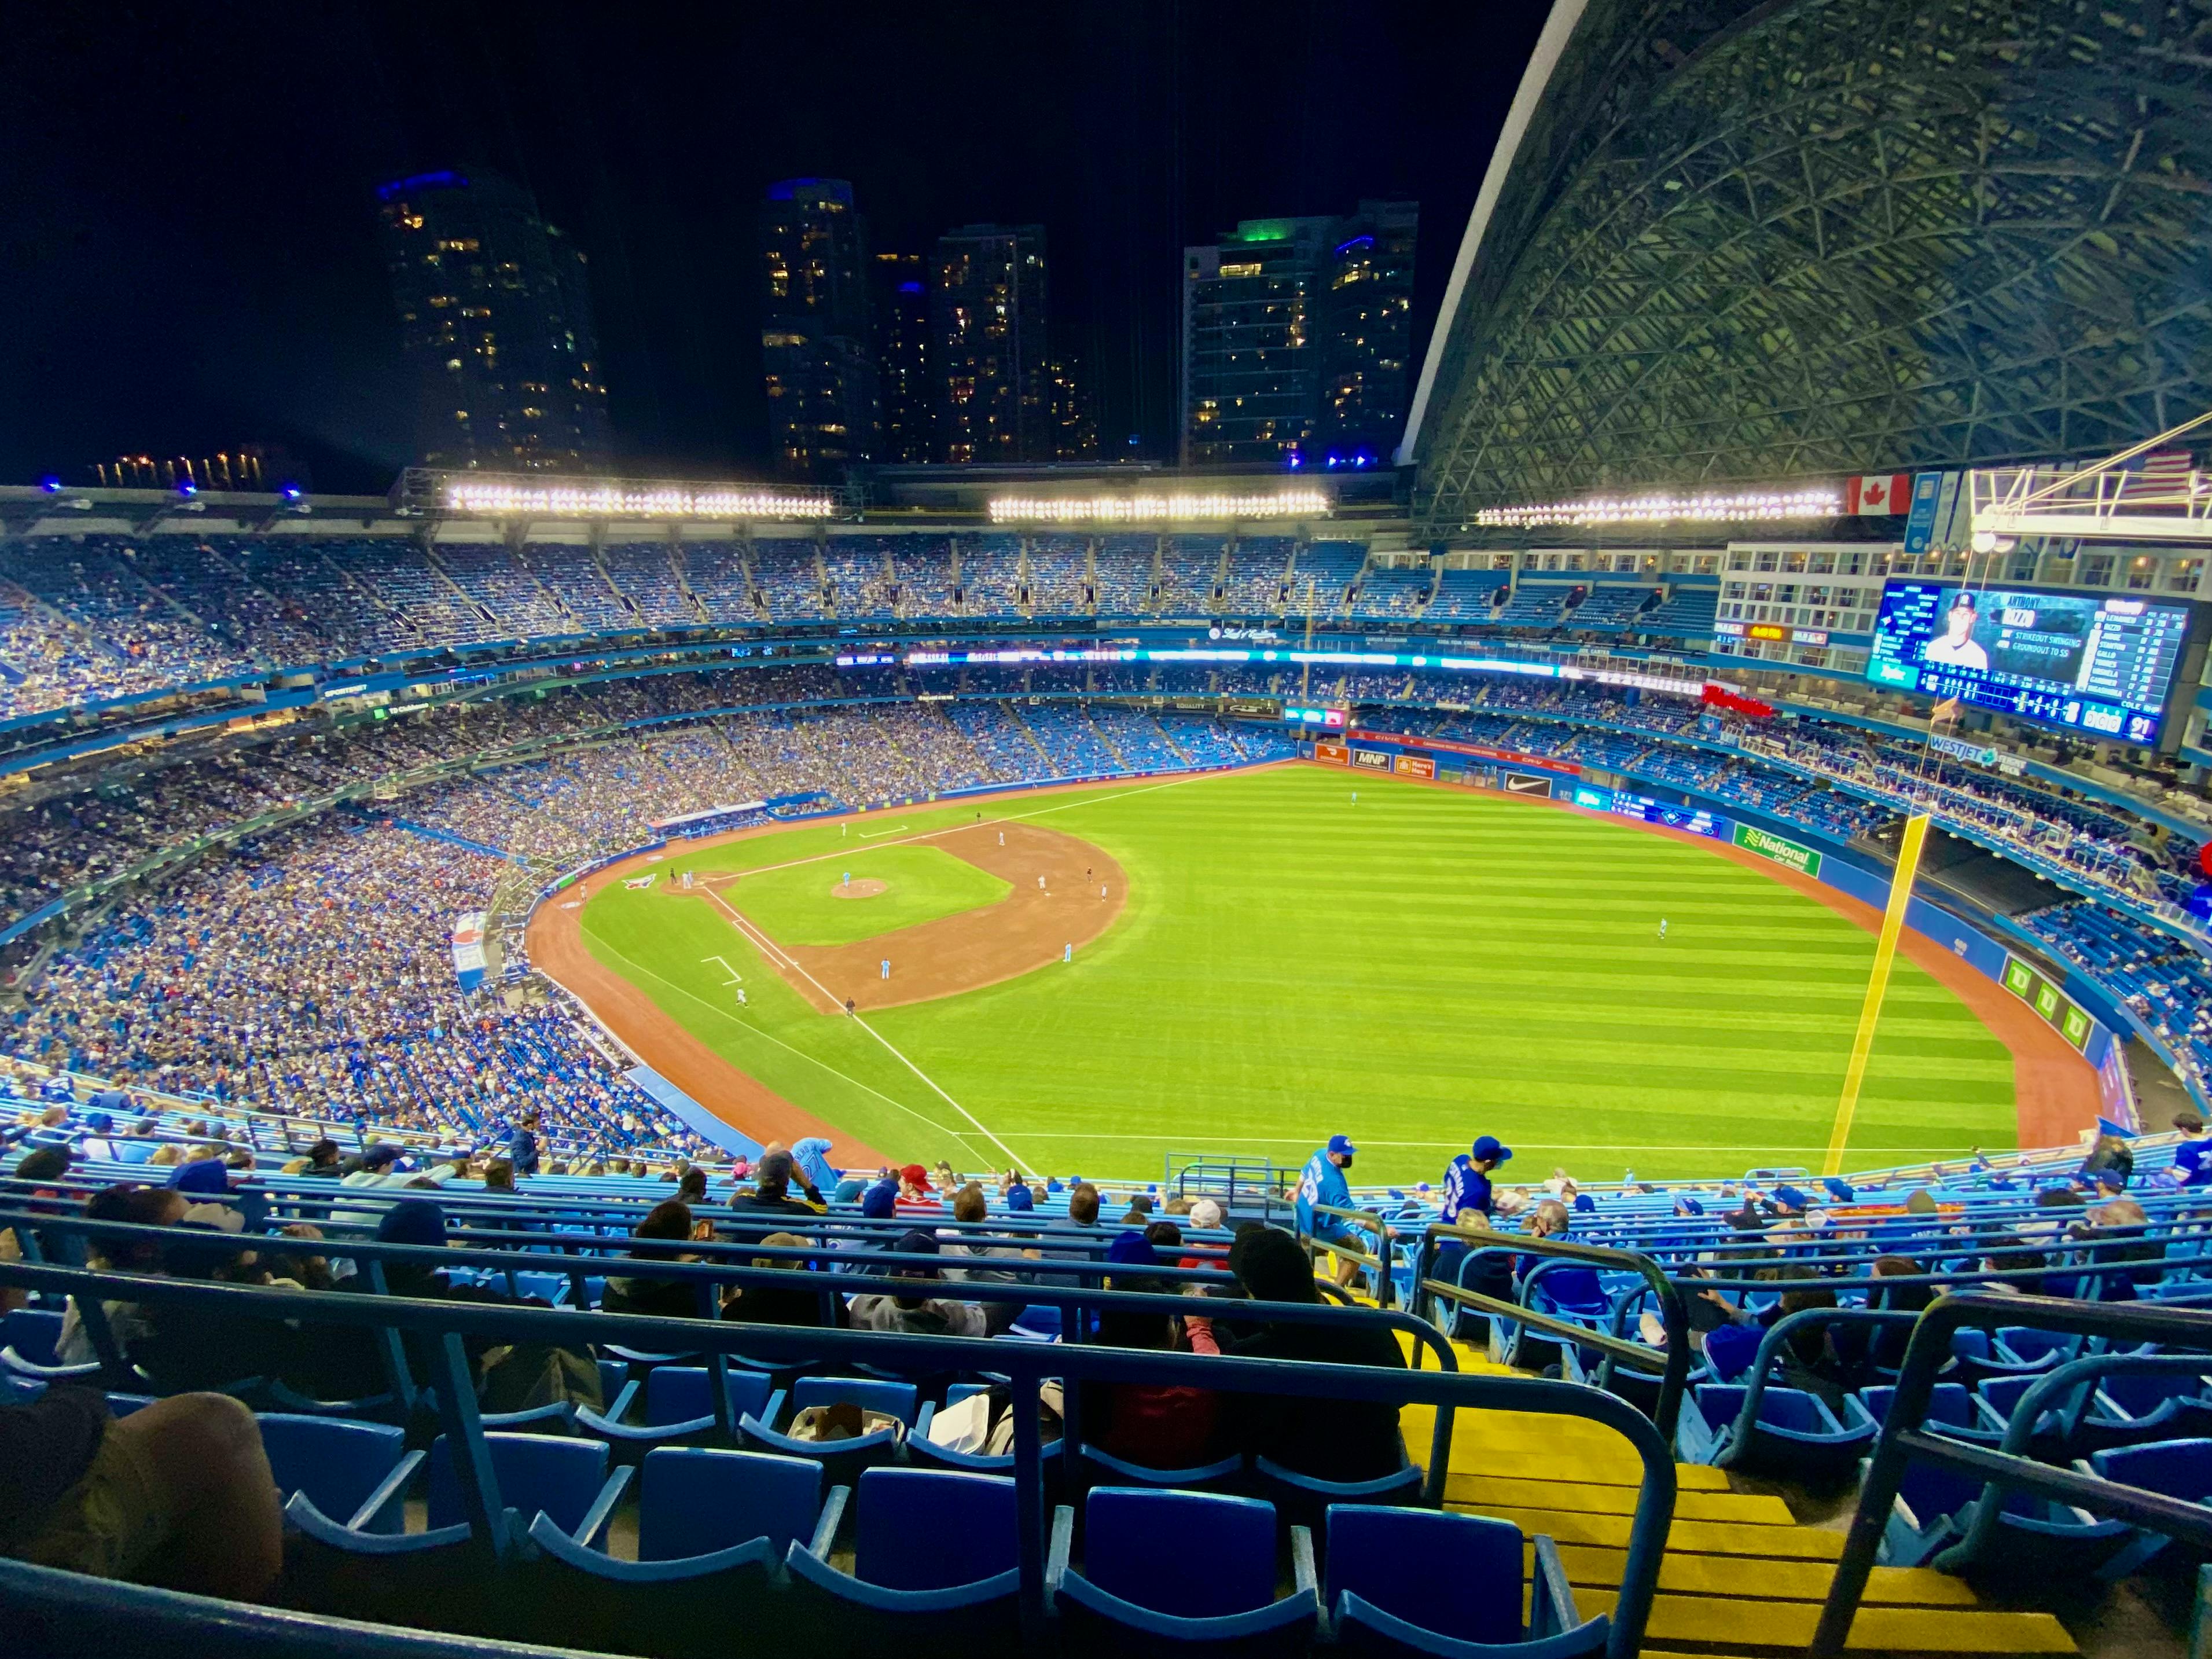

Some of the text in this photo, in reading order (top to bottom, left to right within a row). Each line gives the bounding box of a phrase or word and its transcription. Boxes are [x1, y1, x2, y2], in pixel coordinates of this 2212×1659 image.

[2008, 596, 2040, 608] ANTHONY
[2015, 632, 2048, 643] STRIKEOUT
[2049, 636, 2082, 647] SWINGING
[2012, 643, 2051, 654] GROUNDOUT
[2059, 649, 2070, 657] SS
[2121, 700, 2141, 710] COLE
[2132, 717, 2150, 734] 91
[1375, 735, 1401, 743] CIVIC
[1931, 736, 1982, 760] WESTJET
[1359, 753, 1386, 765] MNP
[1412, 761, 1432, 770] Here's
[1759, 835, 1810, 864] National
